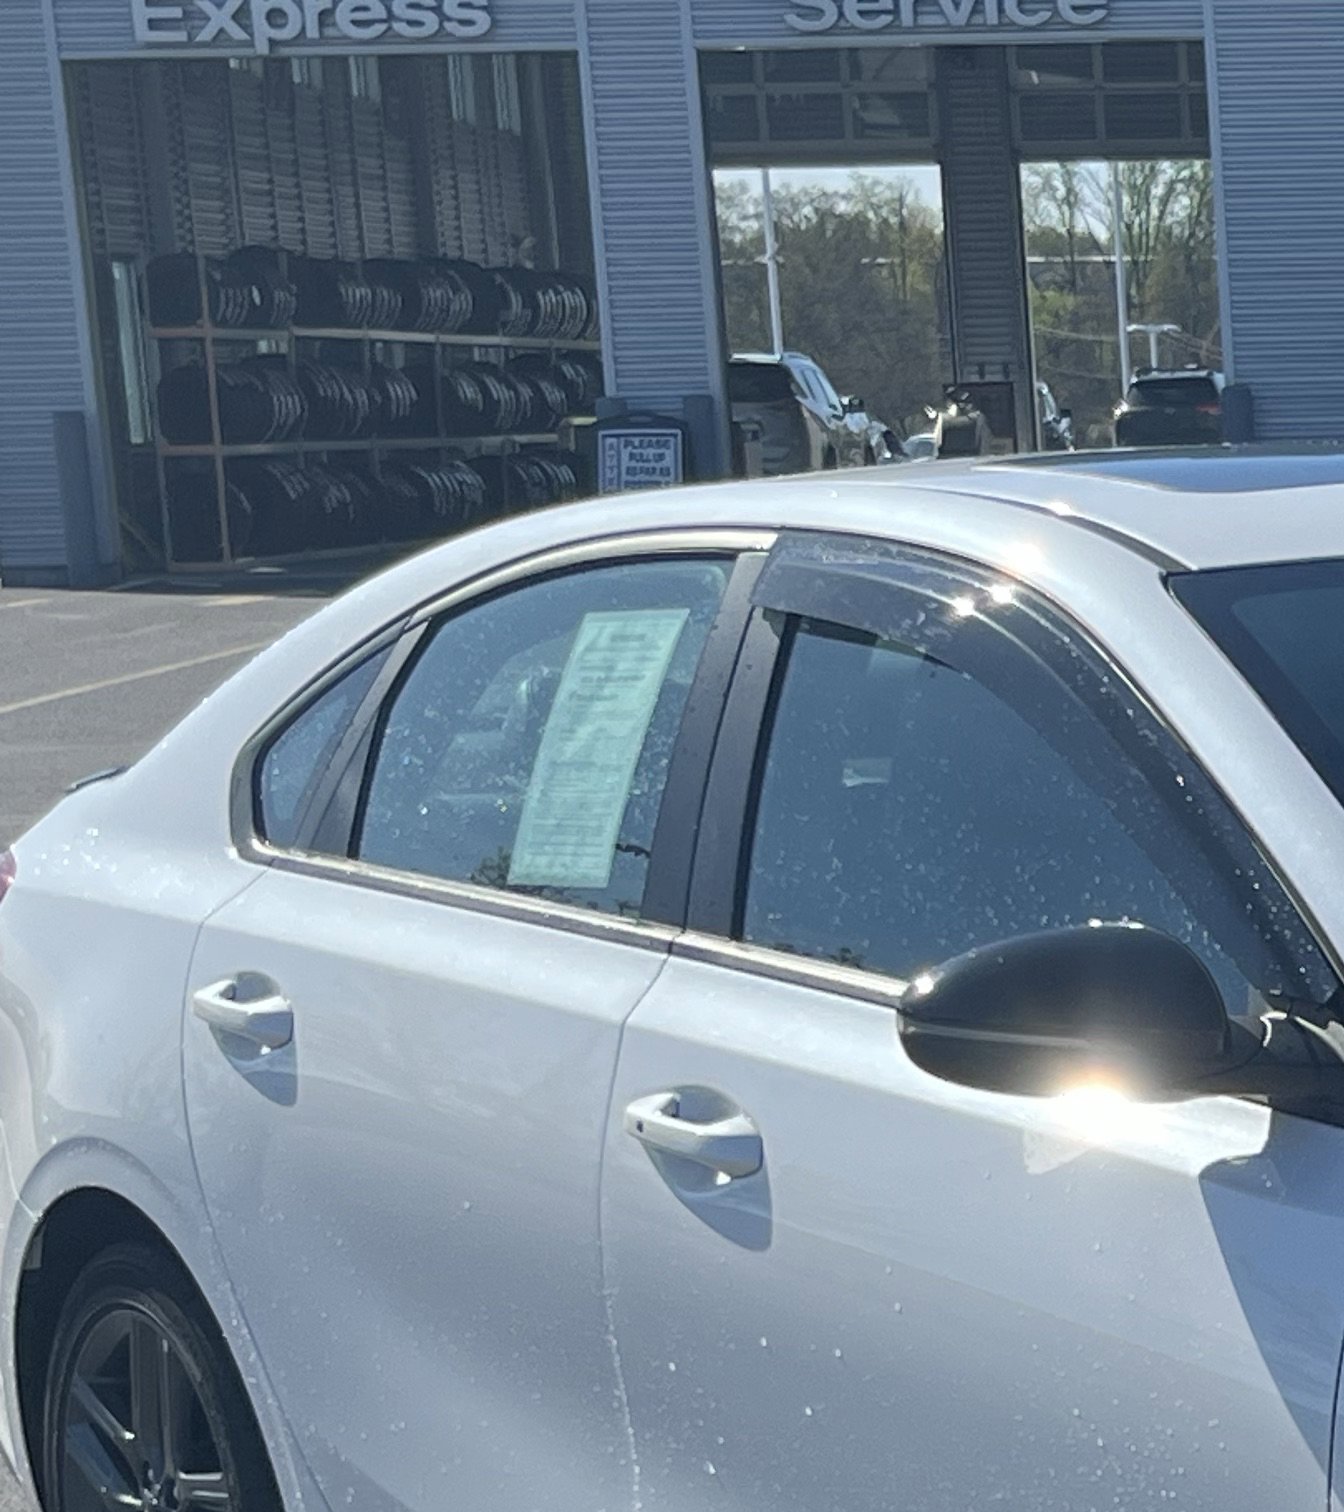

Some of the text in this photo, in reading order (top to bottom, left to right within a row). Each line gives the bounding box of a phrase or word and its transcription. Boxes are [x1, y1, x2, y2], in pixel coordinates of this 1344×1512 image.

[132, 0, 493, 55] Express
[623, 439, 671, 450] PLEASE
[628, 452, 666, 463] PULL UP
